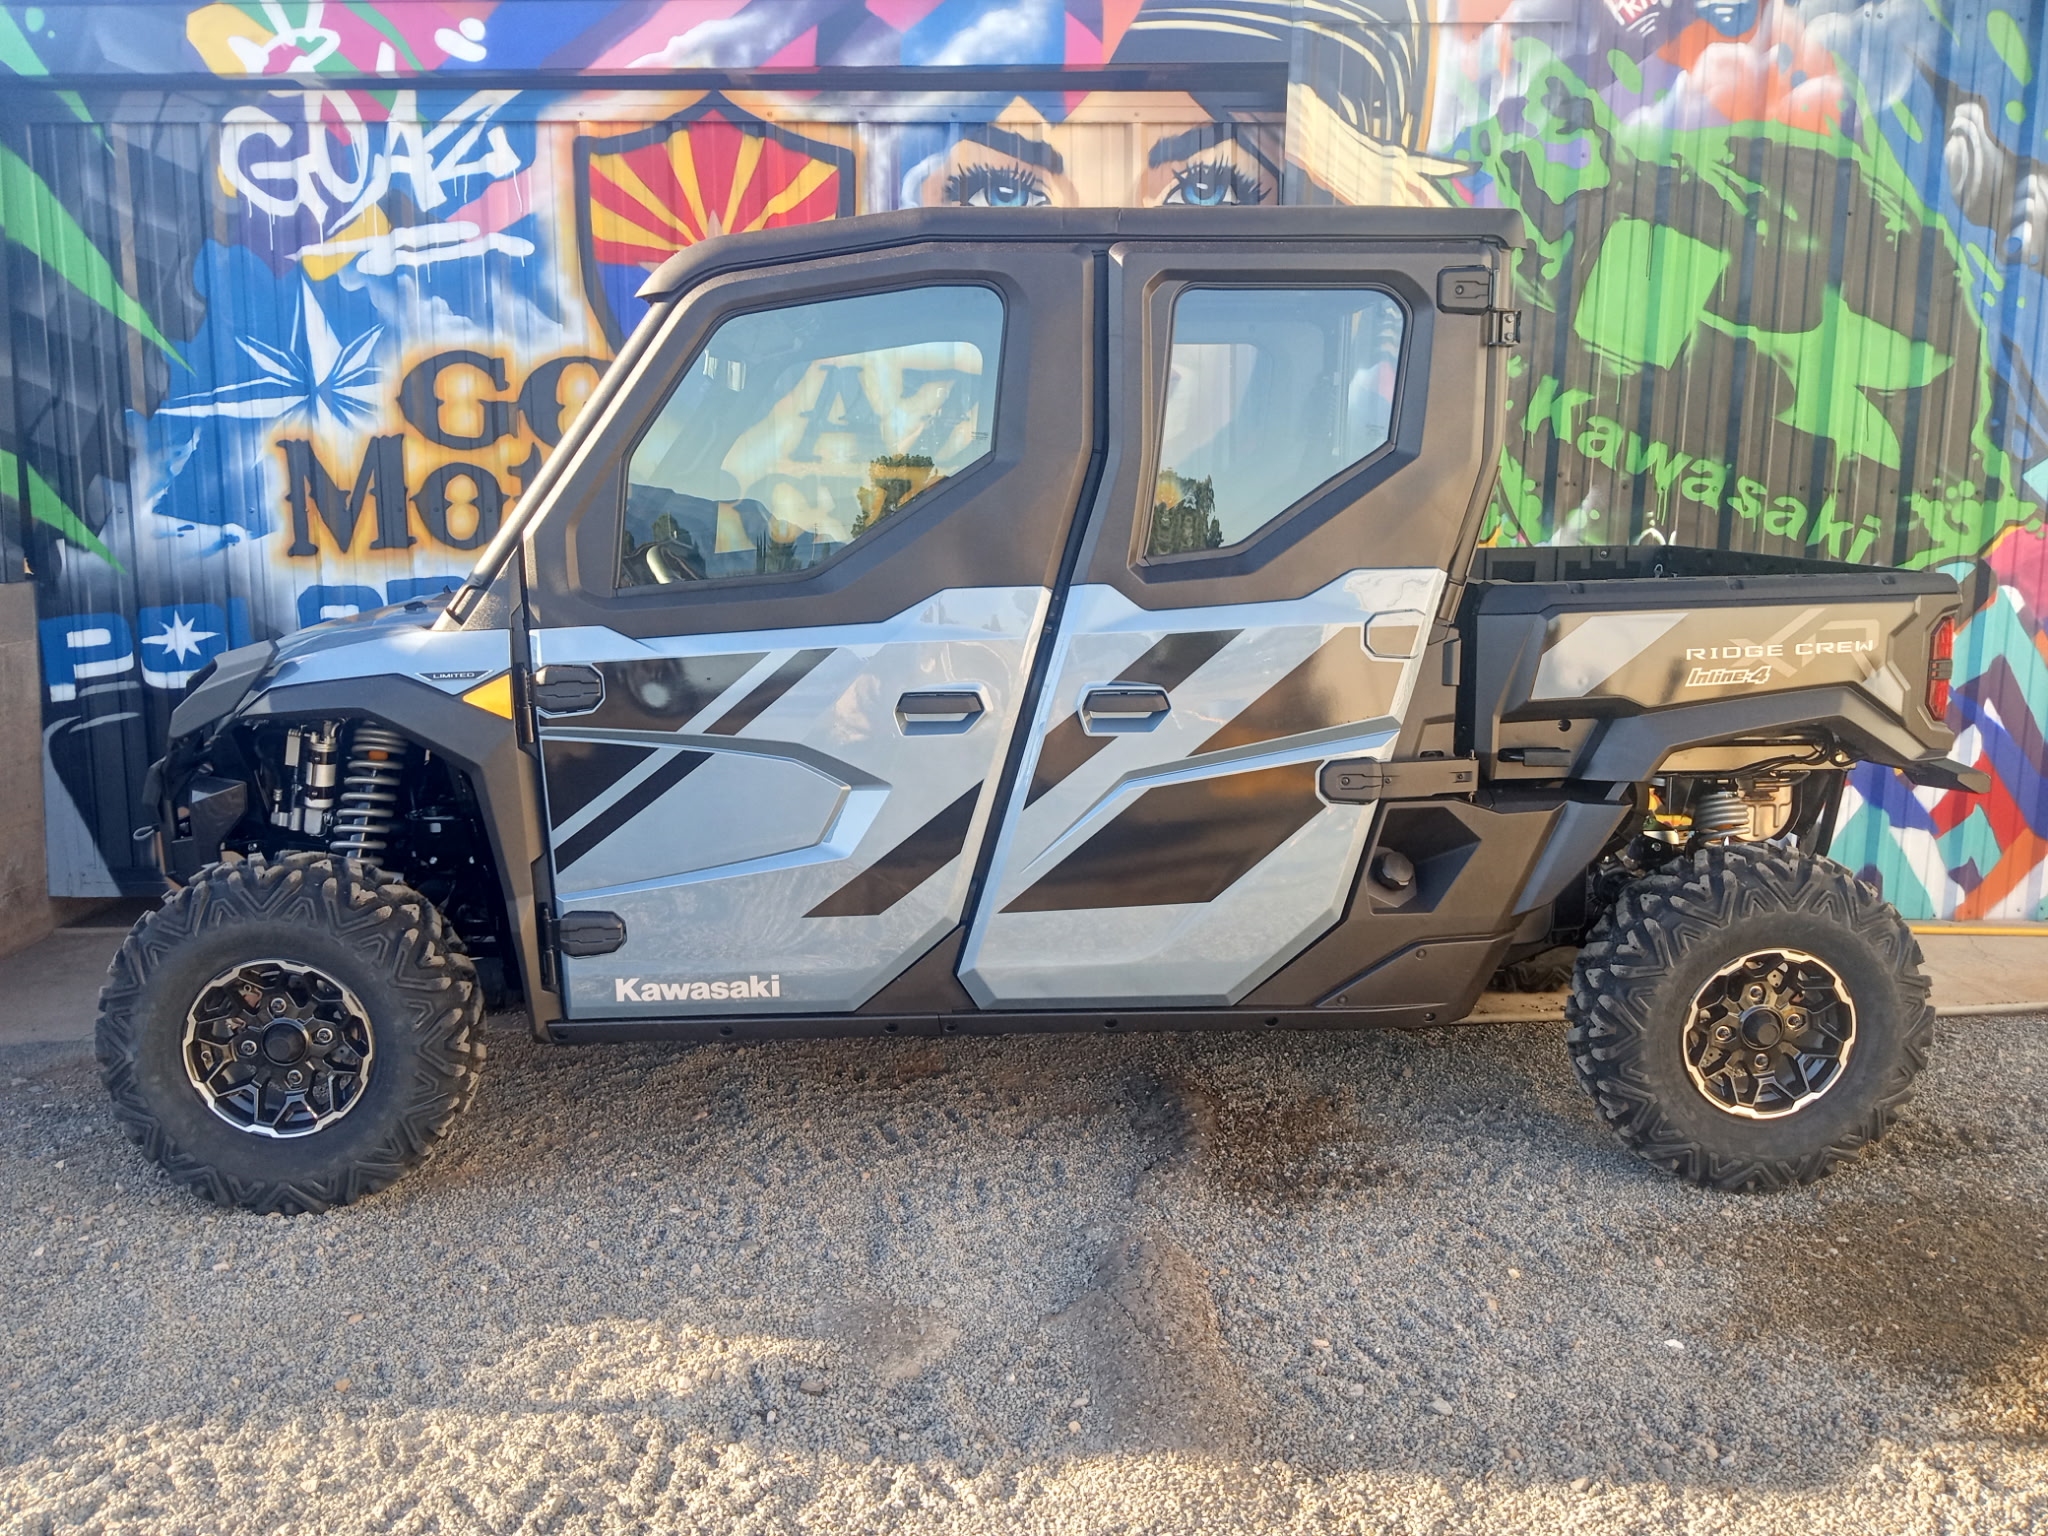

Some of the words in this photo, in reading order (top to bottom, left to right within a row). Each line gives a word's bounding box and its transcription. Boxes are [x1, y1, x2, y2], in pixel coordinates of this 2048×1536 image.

[1520, 374, 1882, 564] Kawasaki
[1685, 644, 1784, 661] RIDGE
[1794, 639, 1874, 656] CREW
[614, 974, 781, 1002] Kawasaki
